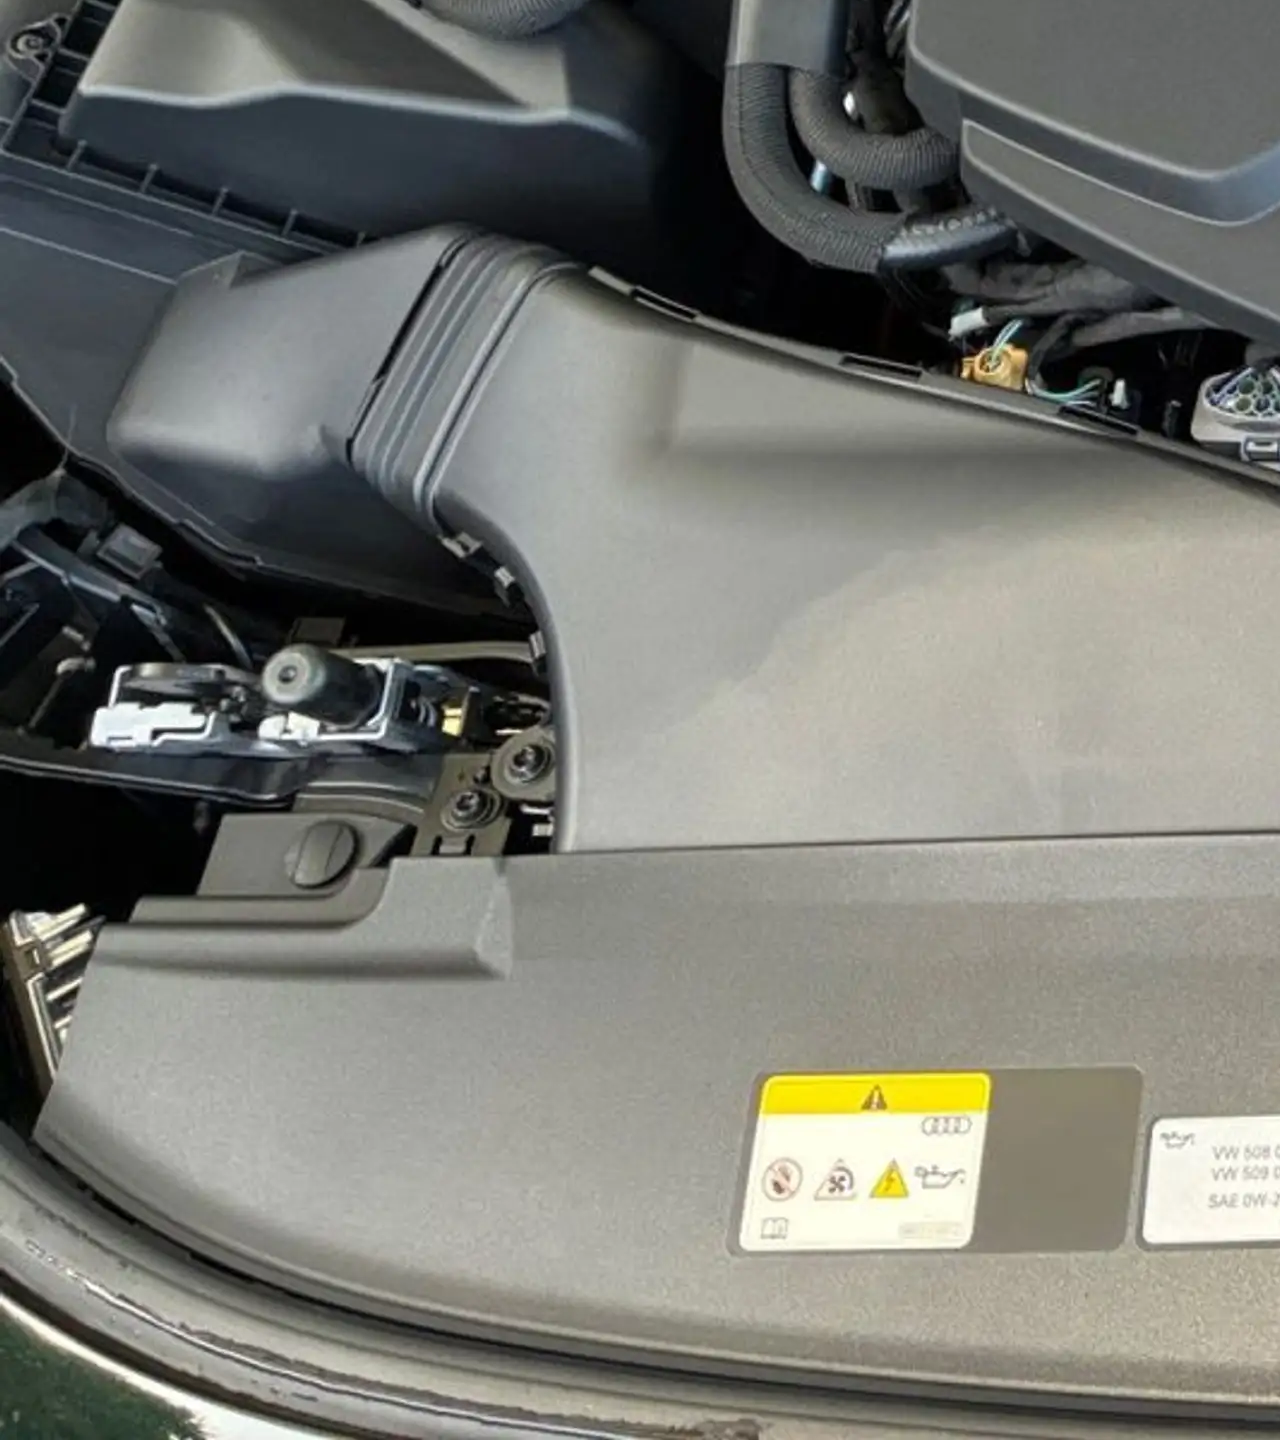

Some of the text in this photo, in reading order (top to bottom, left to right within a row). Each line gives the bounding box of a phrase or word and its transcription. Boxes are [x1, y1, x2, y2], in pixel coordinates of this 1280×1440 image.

[1212, 1146, 1240, 1160] VW
[1243, 1145, 1271, 1160] 508
[1211, 1166, 1239, 1181] VW
[1242, 1166, 1270, 1180] 509
[1208, 1193, 1240, 1208] SAE
